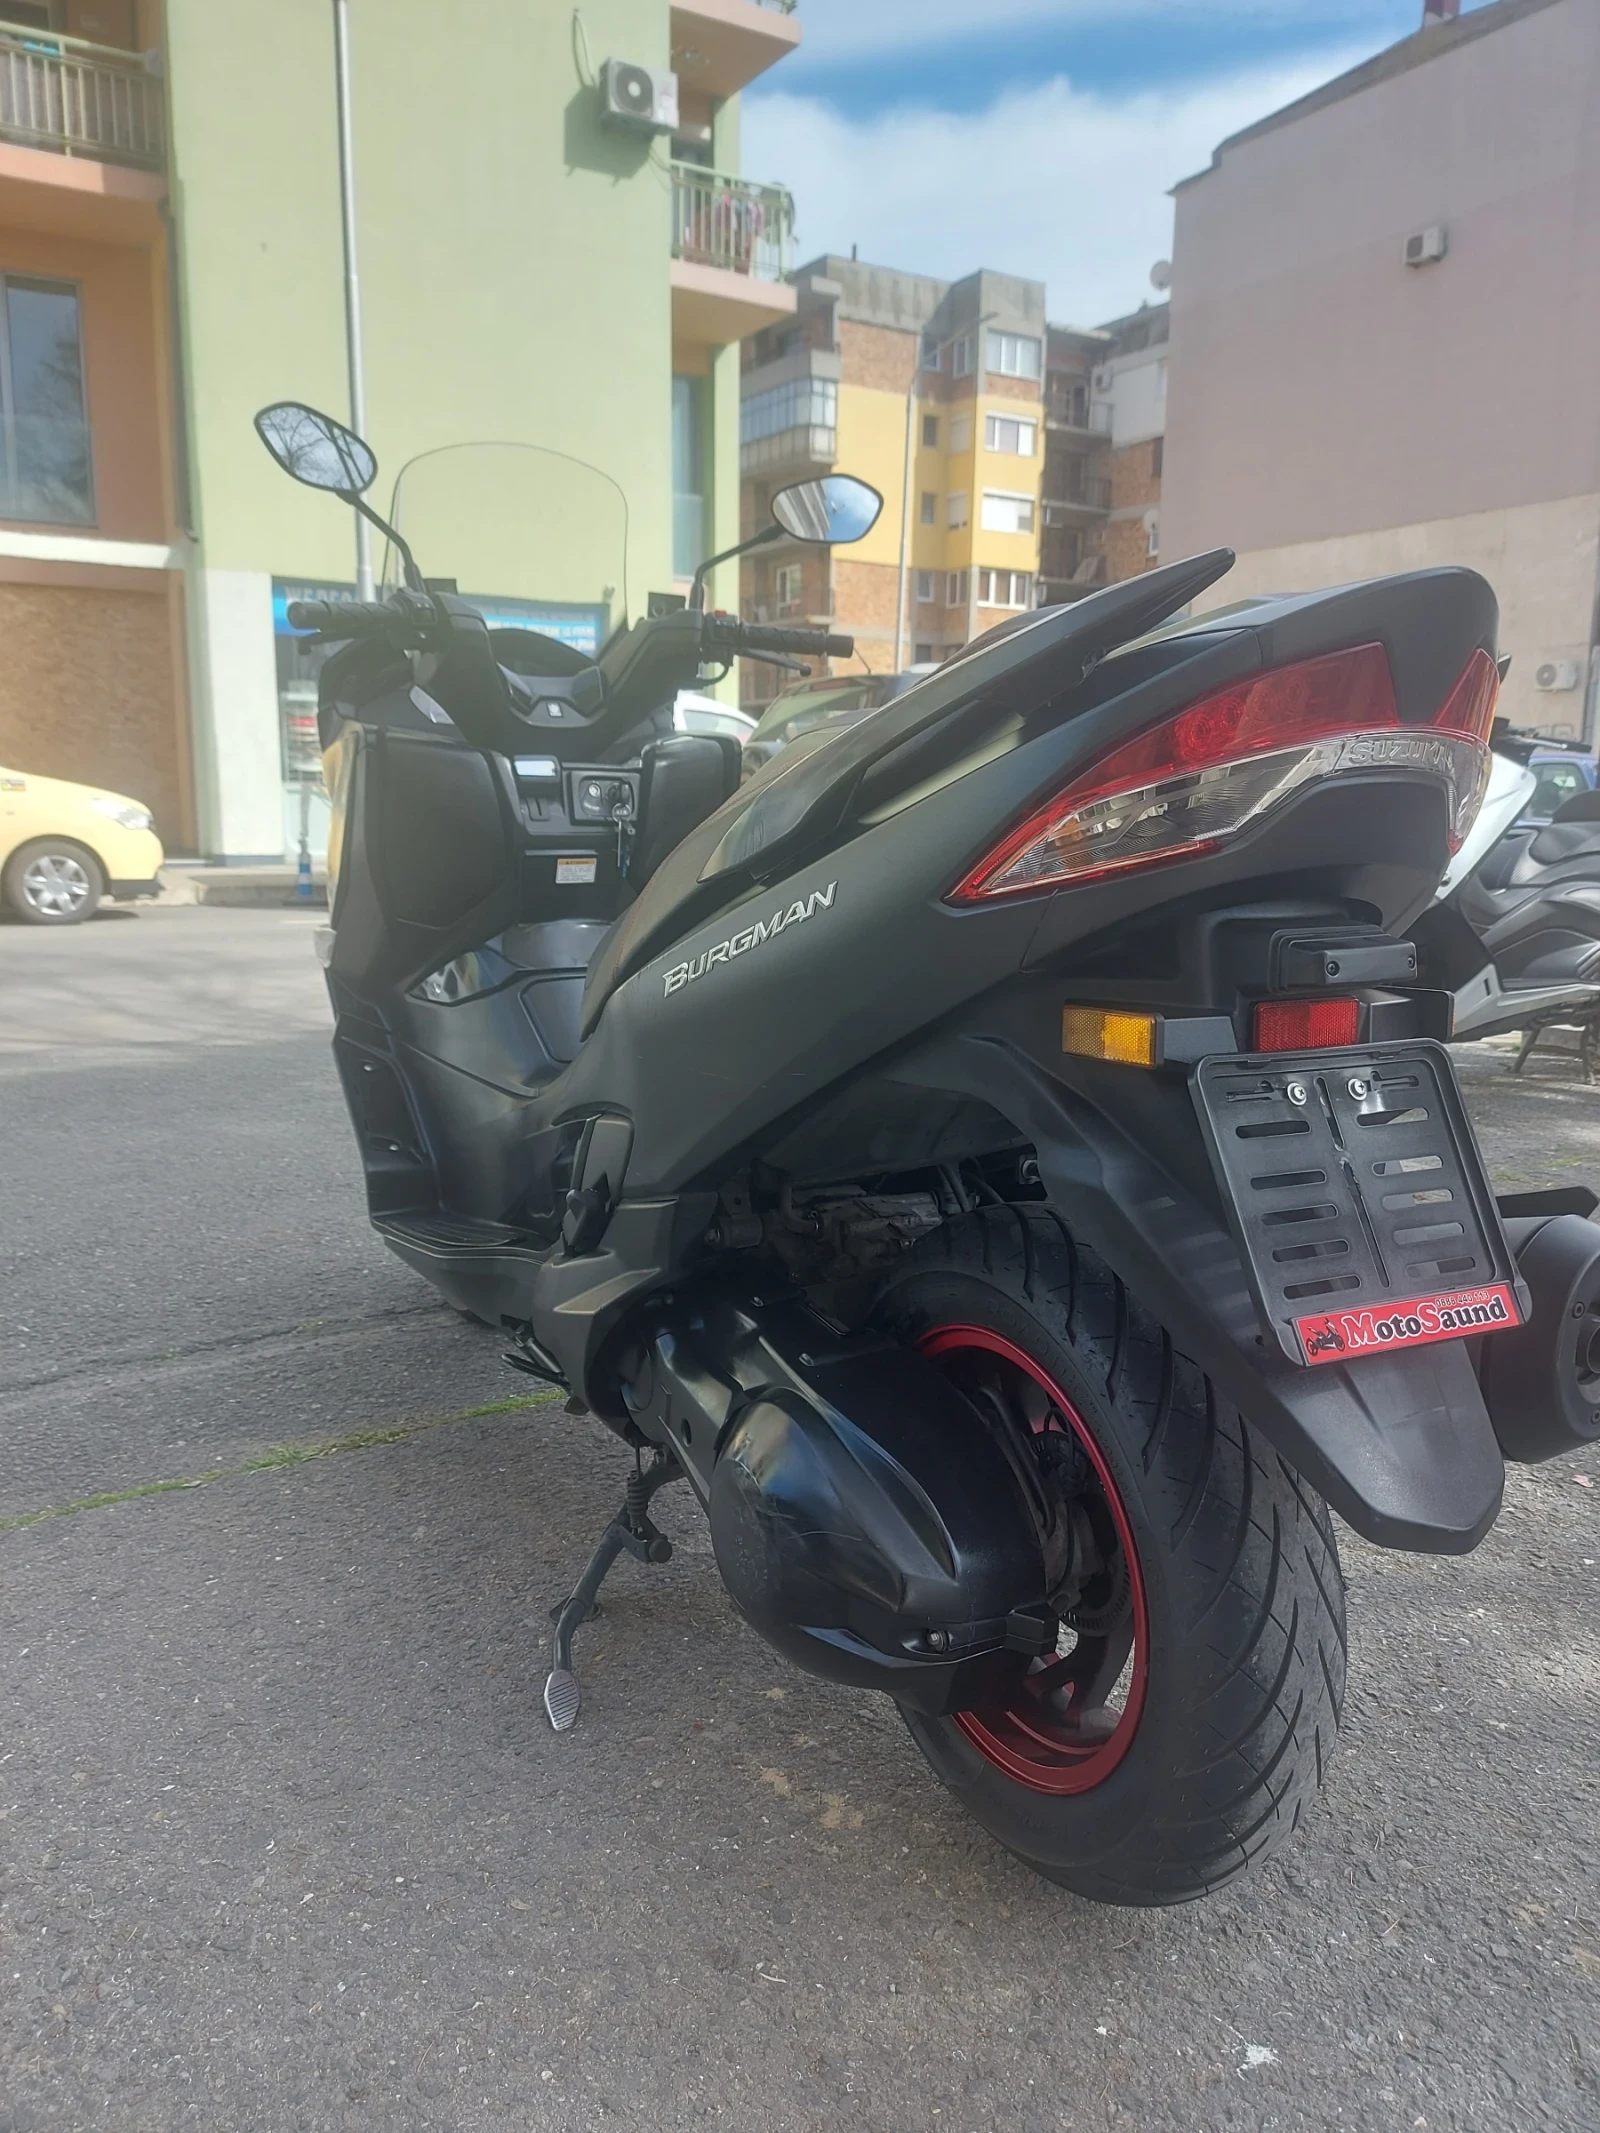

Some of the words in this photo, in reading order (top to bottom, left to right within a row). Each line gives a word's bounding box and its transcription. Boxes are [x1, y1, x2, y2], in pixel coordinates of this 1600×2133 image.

[662, 880, 838, 998] BURGMAN
[1341, 1295, 1508, 1348] MotoSaund
[1435, 1296, 1456, 1308] 0888
[1458, 1294, 1473, 1304] 440
[1474, 1290, 1489, 1301] 113
